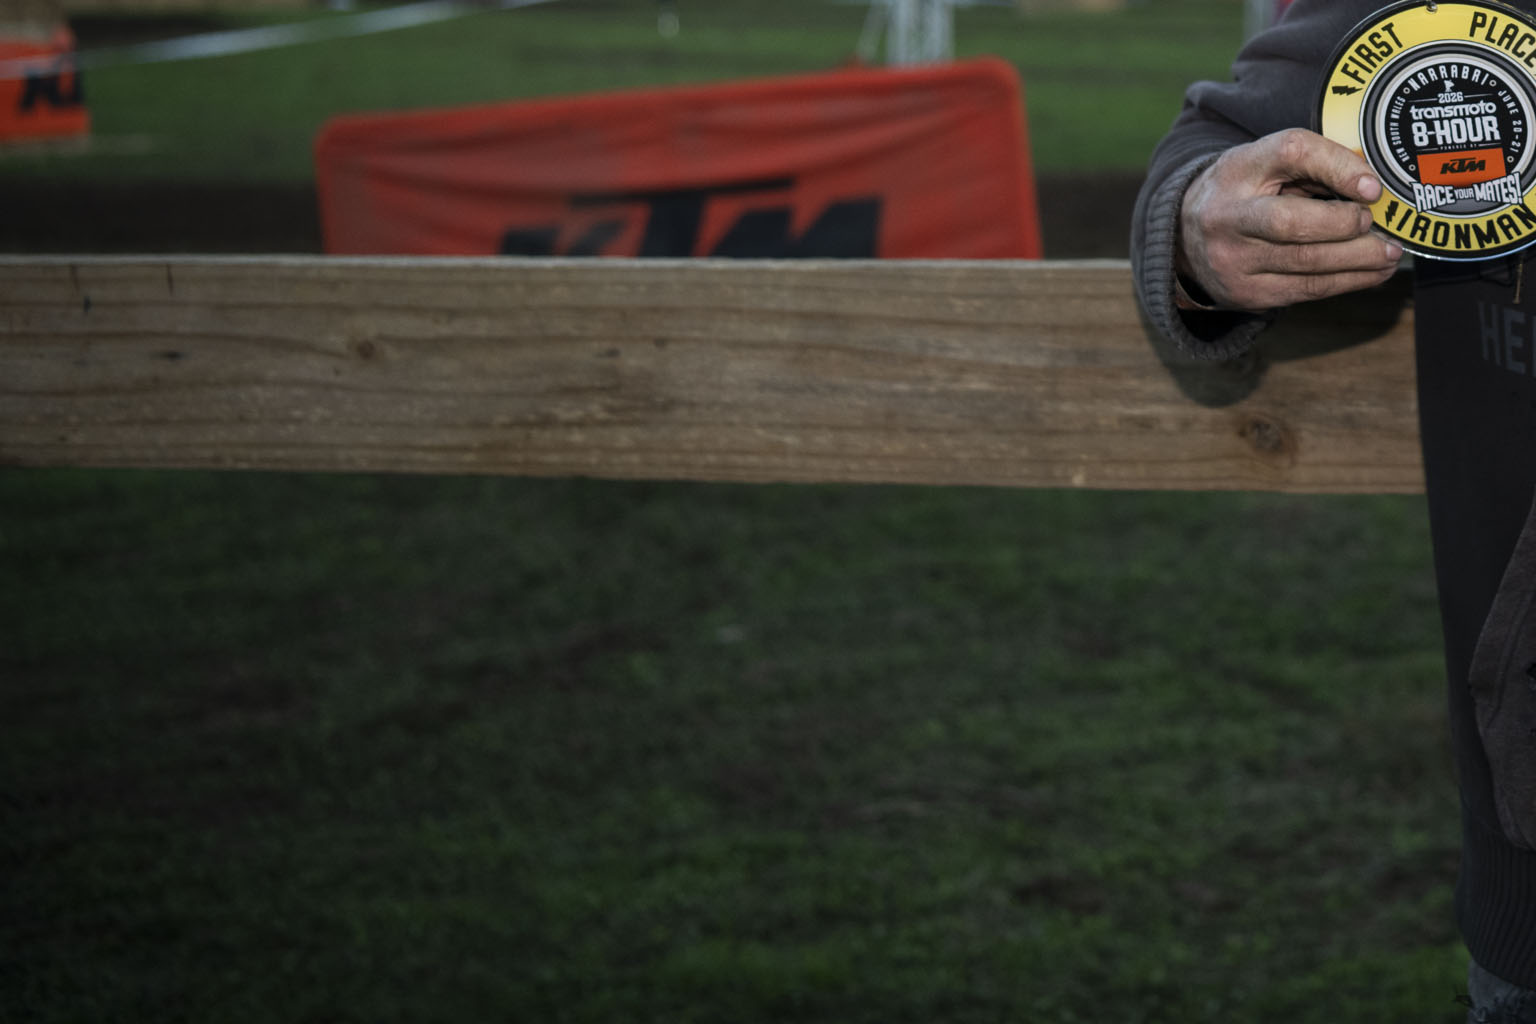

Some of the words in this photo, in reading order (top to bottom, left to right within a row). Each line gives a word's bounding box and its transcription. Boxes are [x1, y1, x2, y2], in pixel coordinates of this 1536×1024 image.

[1340, 22, 1404, 85] FIRST
[1407, 64, 1490, 91] NARRABRI
[1390, 96, 1406, 119] WALES
[1410, 100, 1497, 120] transmoto
[1438, 92, 1464, 103] 2026
[1389, 121, 1402, 146] SOUTH
[1411, 115, 1501, 147] 8-HOUR
[1498, 90, 1520, 115] JUNE
[1510, 119, 1523, 153] 20-21
[1440, 157, 1486, 175] KTM
[1411, 181, 1456, 213] RACE
[1454, 187, 1474, 200] YOUR
[1473, 172, 1523, 205] MATES!
